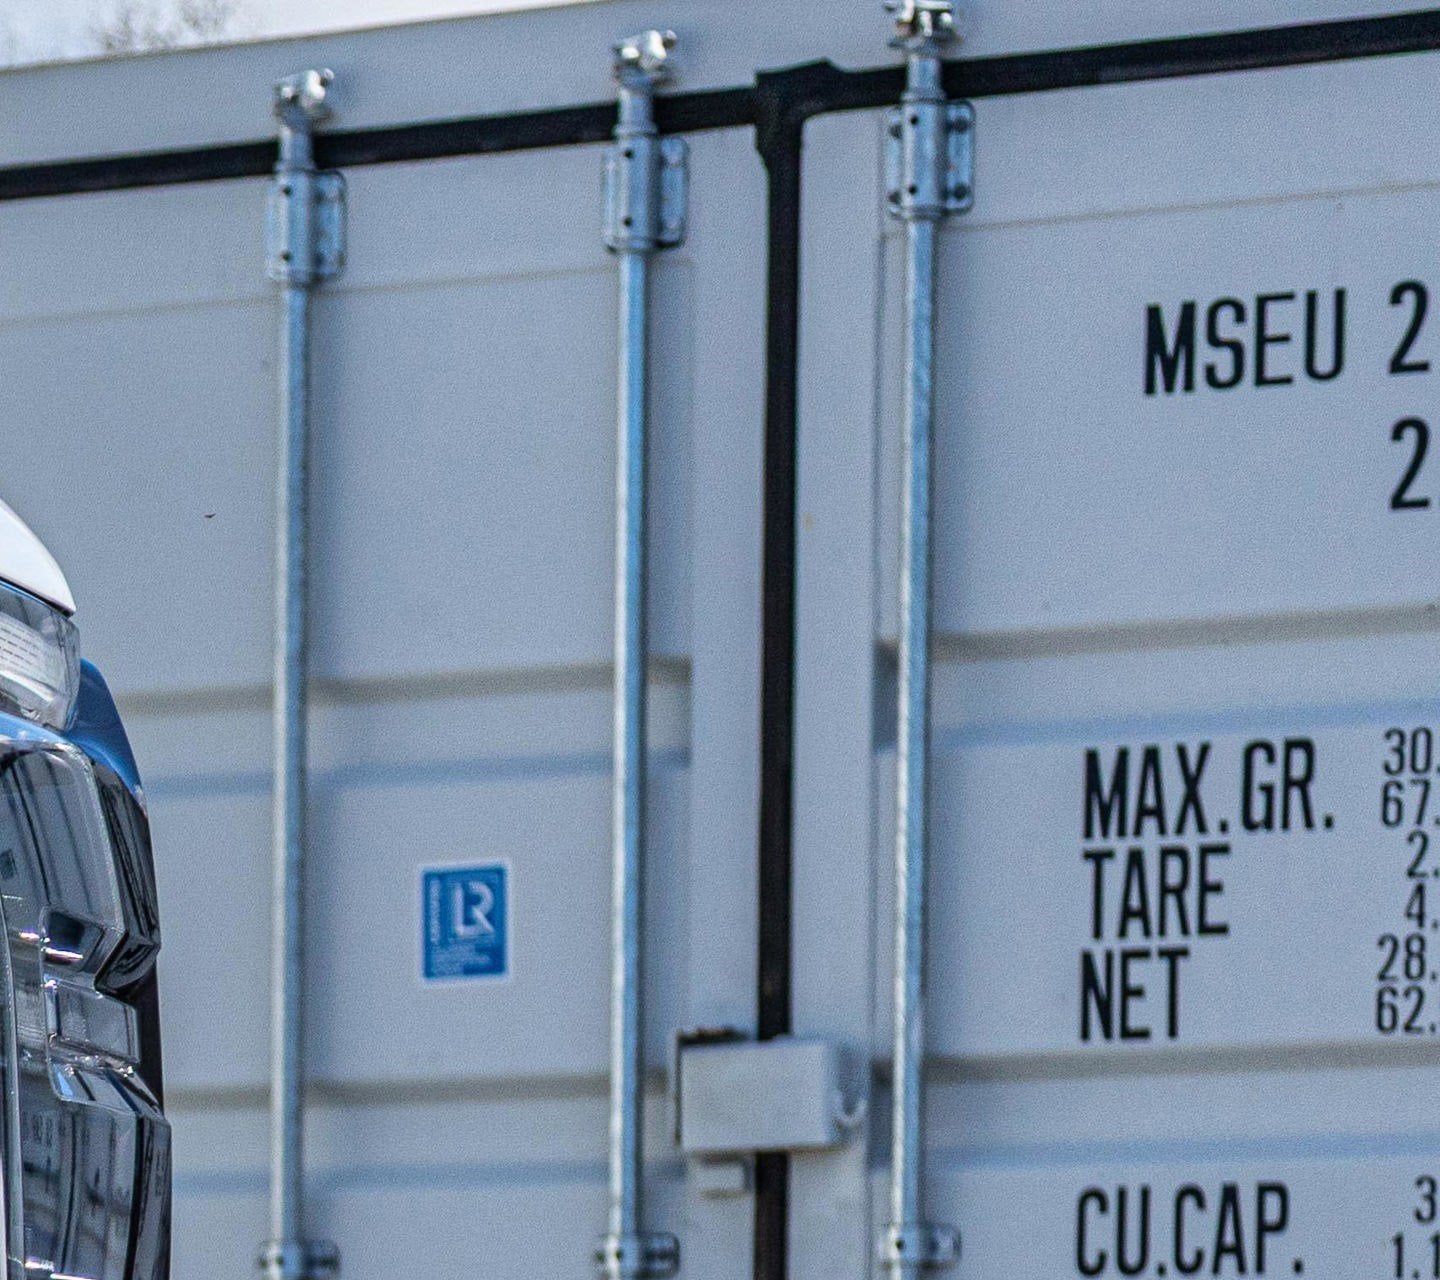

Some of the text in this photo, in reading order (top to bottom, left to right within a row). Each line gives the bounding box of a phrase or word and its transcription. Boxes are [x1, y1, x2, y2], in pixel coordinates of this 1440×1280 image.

[1144, 279, 1429, 396] MSEU 2
[1389, 416, 1430, 510] 2
[1081, 737, 1335, 840] MAX.GR.
[1082, 844, 1231, 942] TARE
[1080, 947, 1190, 1042] NET
[1076, 1181, 1305, 1278] CU.CAP.
